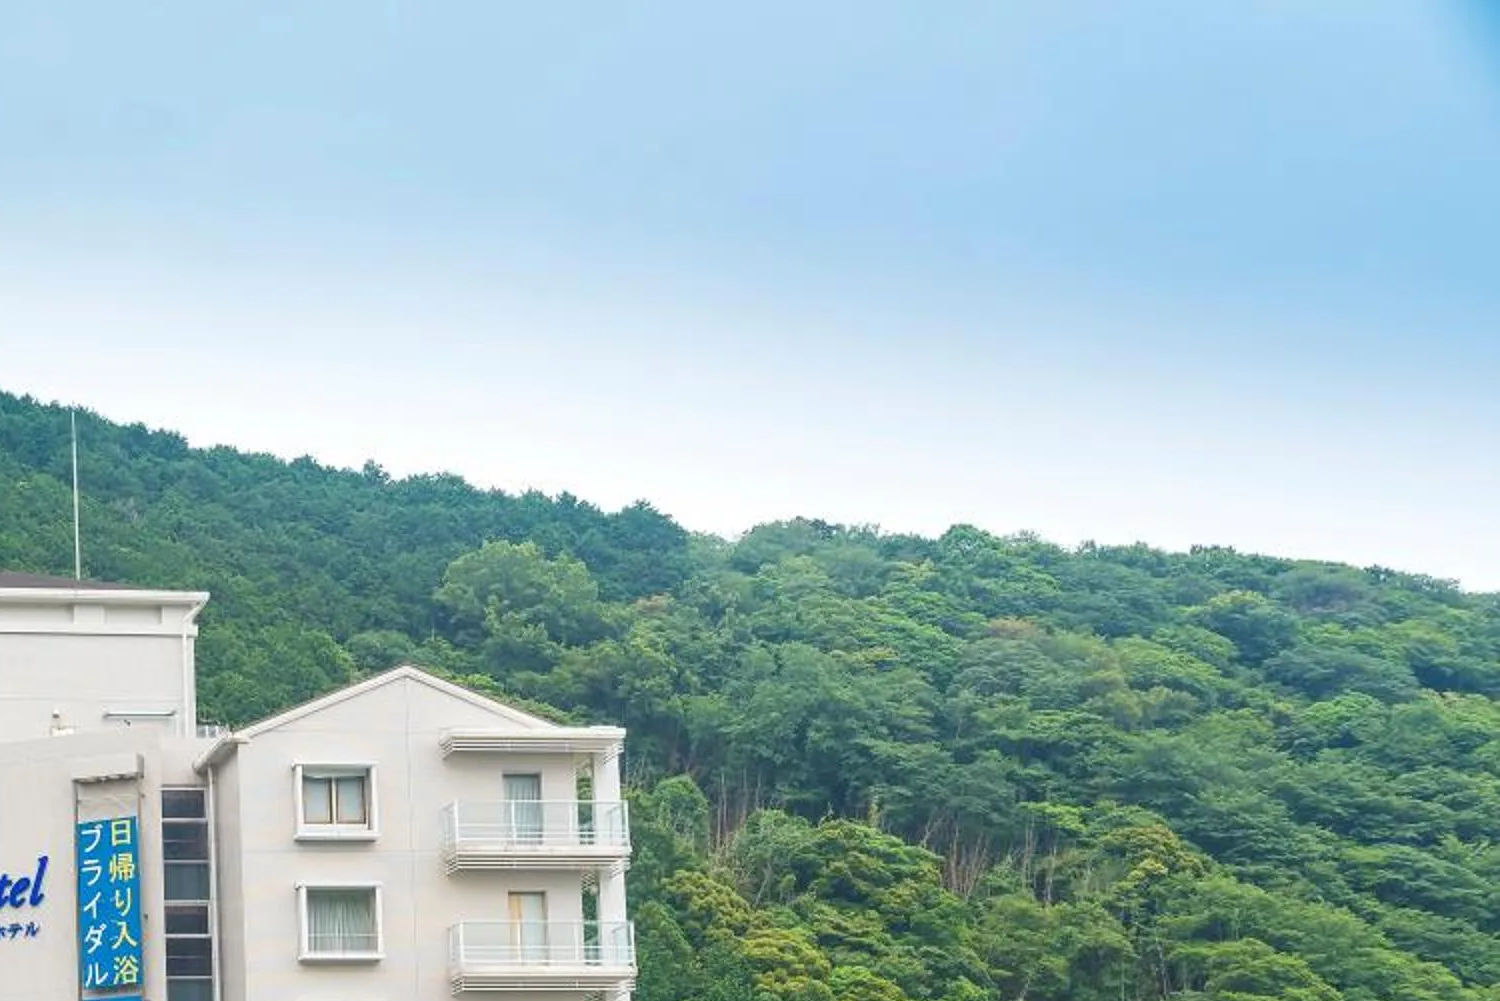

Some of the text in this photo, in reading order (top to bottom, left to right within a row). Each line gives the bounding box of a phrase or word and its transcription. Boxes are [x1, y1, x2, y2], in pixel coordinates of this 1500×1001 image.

[80, 824, 108, 988] ブライダル
[108, 818, 139, 985] 日帰り入浴
